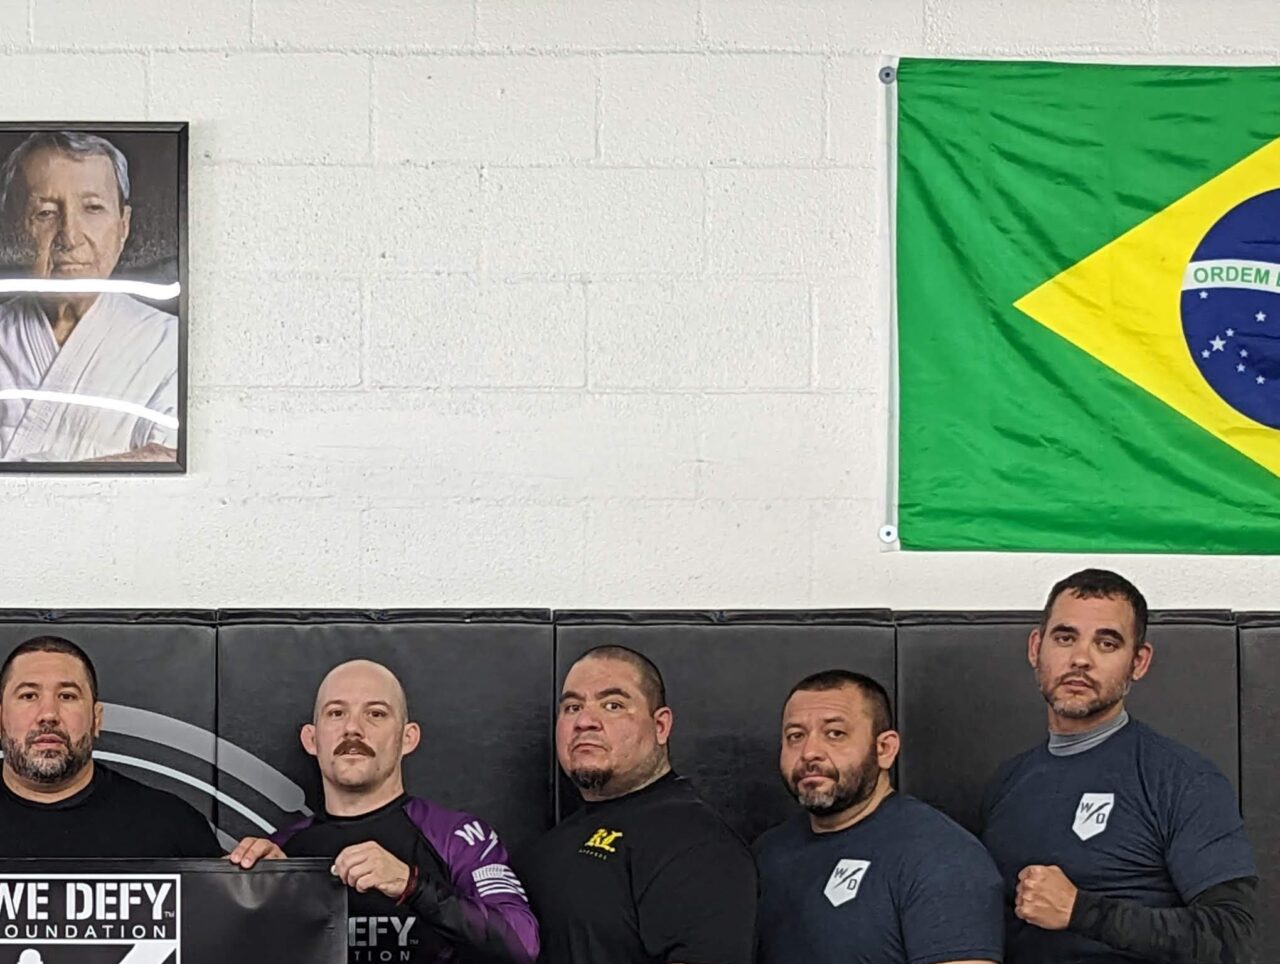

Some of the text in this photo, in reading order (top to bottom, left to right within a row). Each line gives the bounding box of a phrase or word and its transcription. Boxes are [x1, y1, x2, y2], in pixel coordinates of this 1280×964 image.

[1193, 265, 1271, 286] ORDEM
[65, 882, 172, 921] DEFY
[347, 916, 417, 947] EFY
